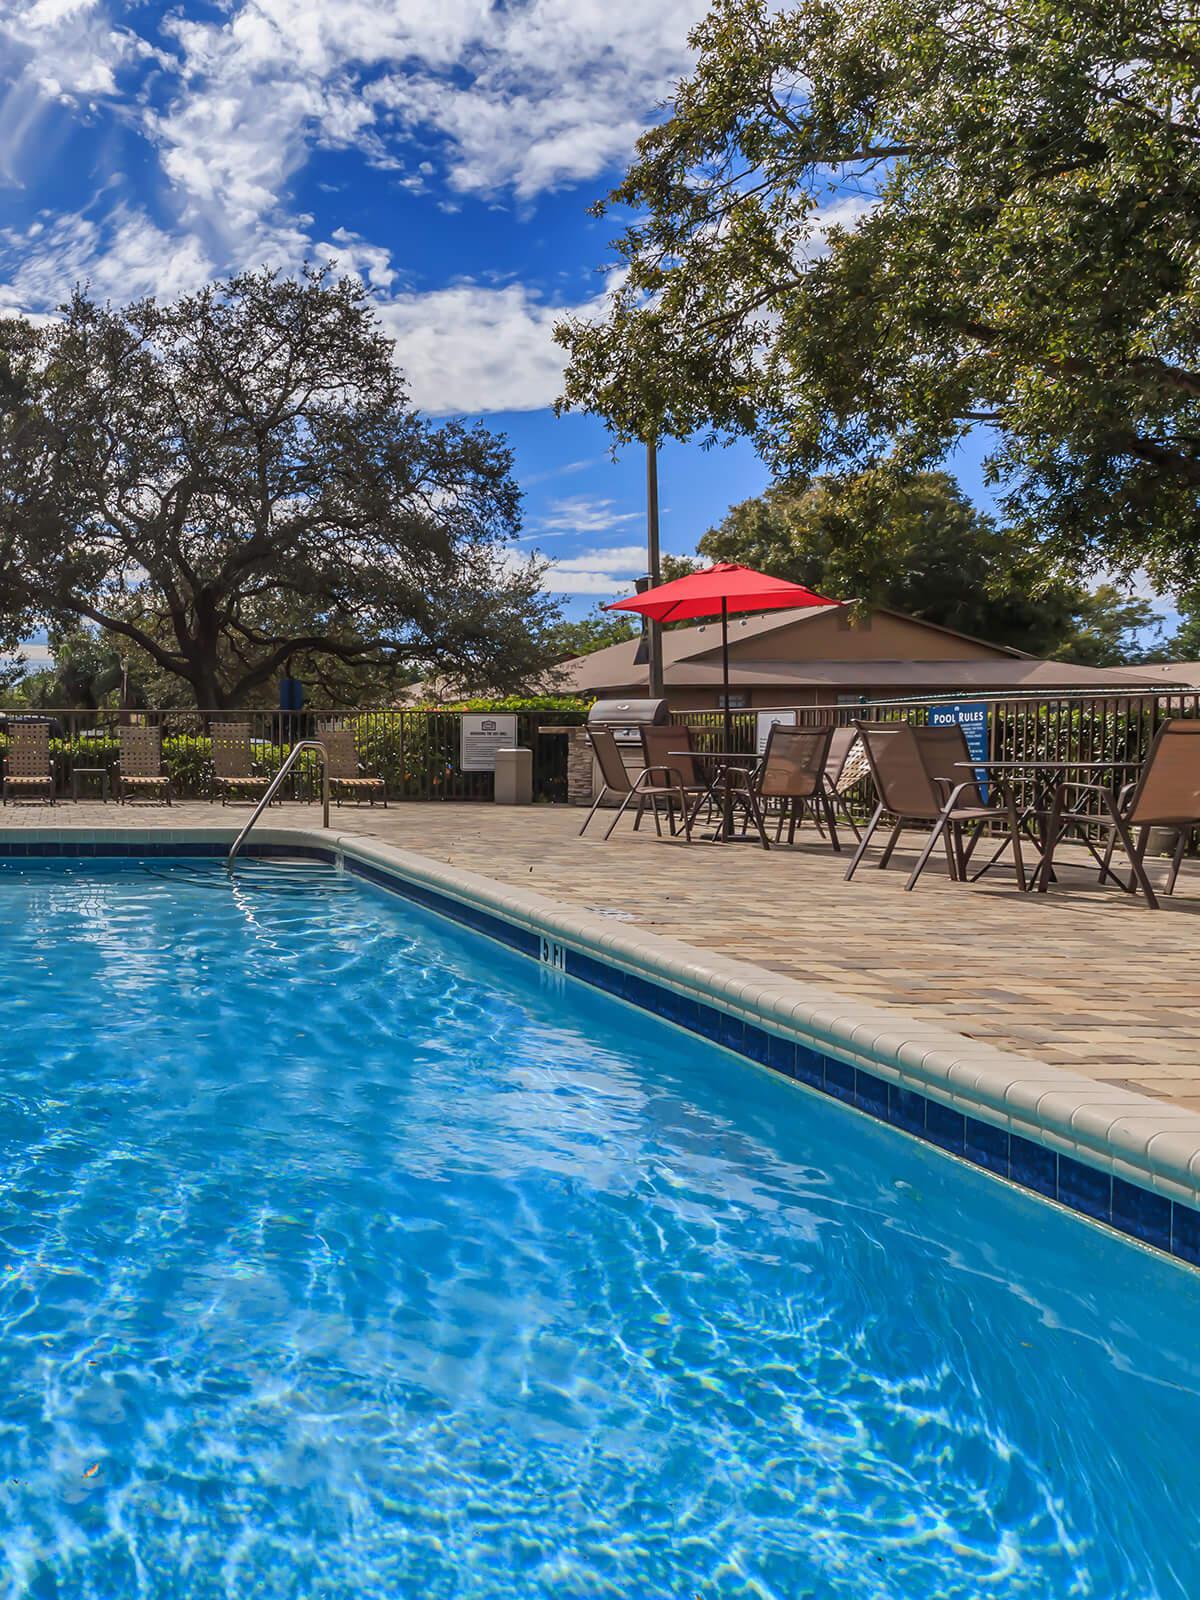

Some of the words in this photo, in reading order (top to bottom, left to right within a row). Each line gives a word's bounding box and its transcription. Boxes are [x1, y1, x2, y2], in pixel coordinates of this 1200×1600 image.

[934, 714, 956, 724] POOL
[958, 711, 984, 722] RULES
[543, 938, 549, 962] 5
